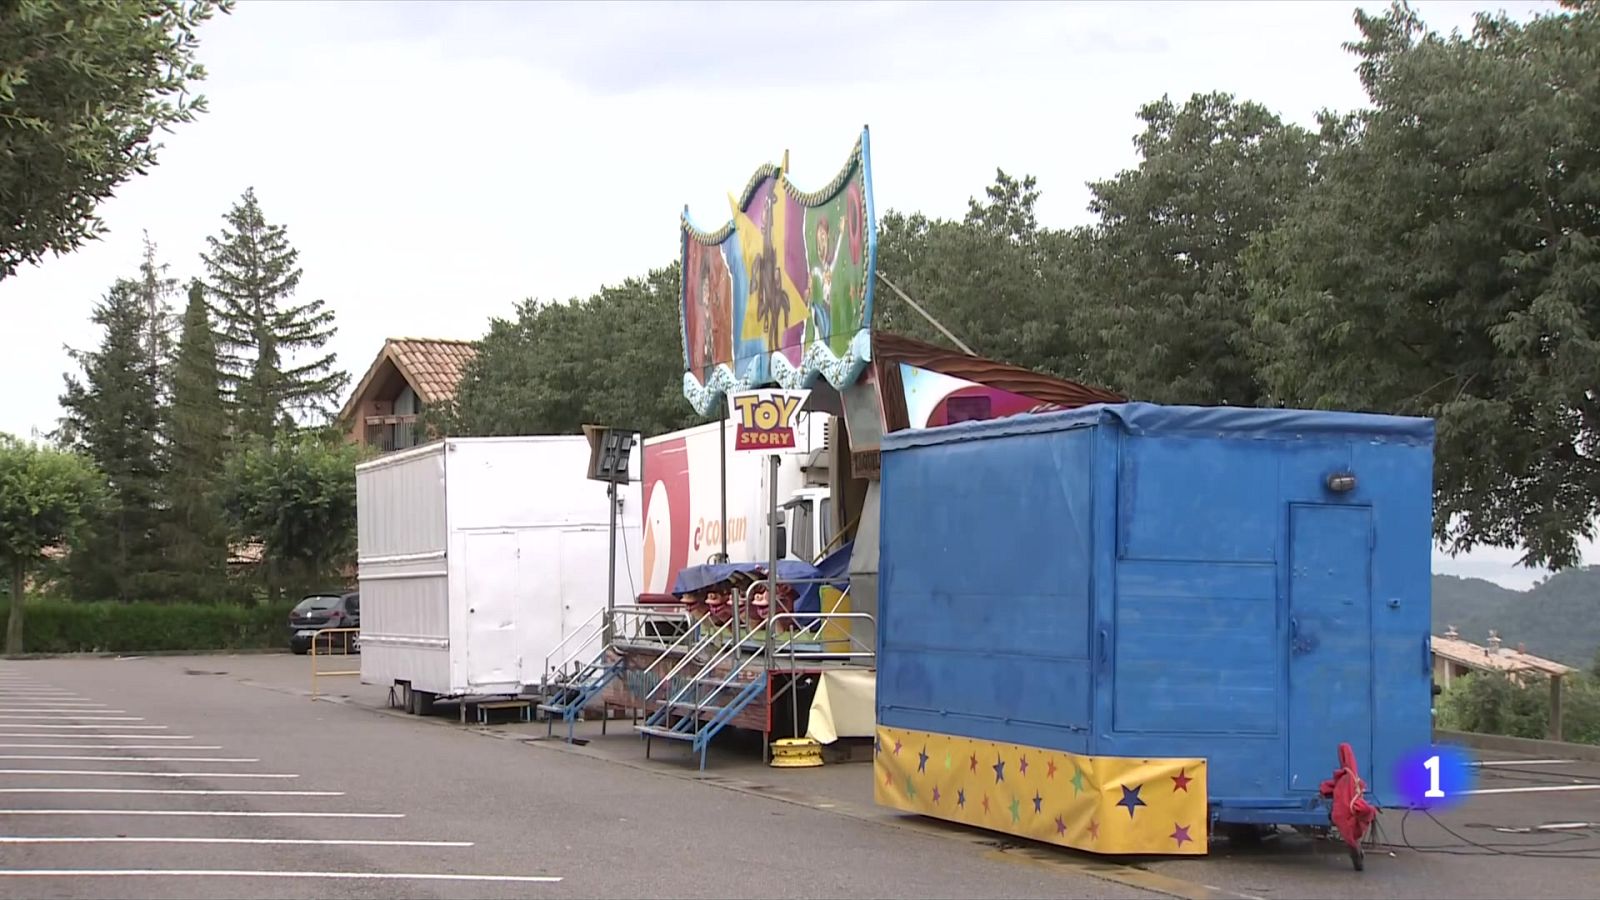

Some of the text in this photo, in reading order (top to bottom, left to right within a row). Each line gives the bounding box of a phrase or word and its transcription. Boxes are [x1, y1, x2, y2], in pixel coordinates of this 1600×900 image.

[734, 394, 802, 431] TOY
[741, 432, 790, 444] STORY
[706, 516, 747, 546] cosun
